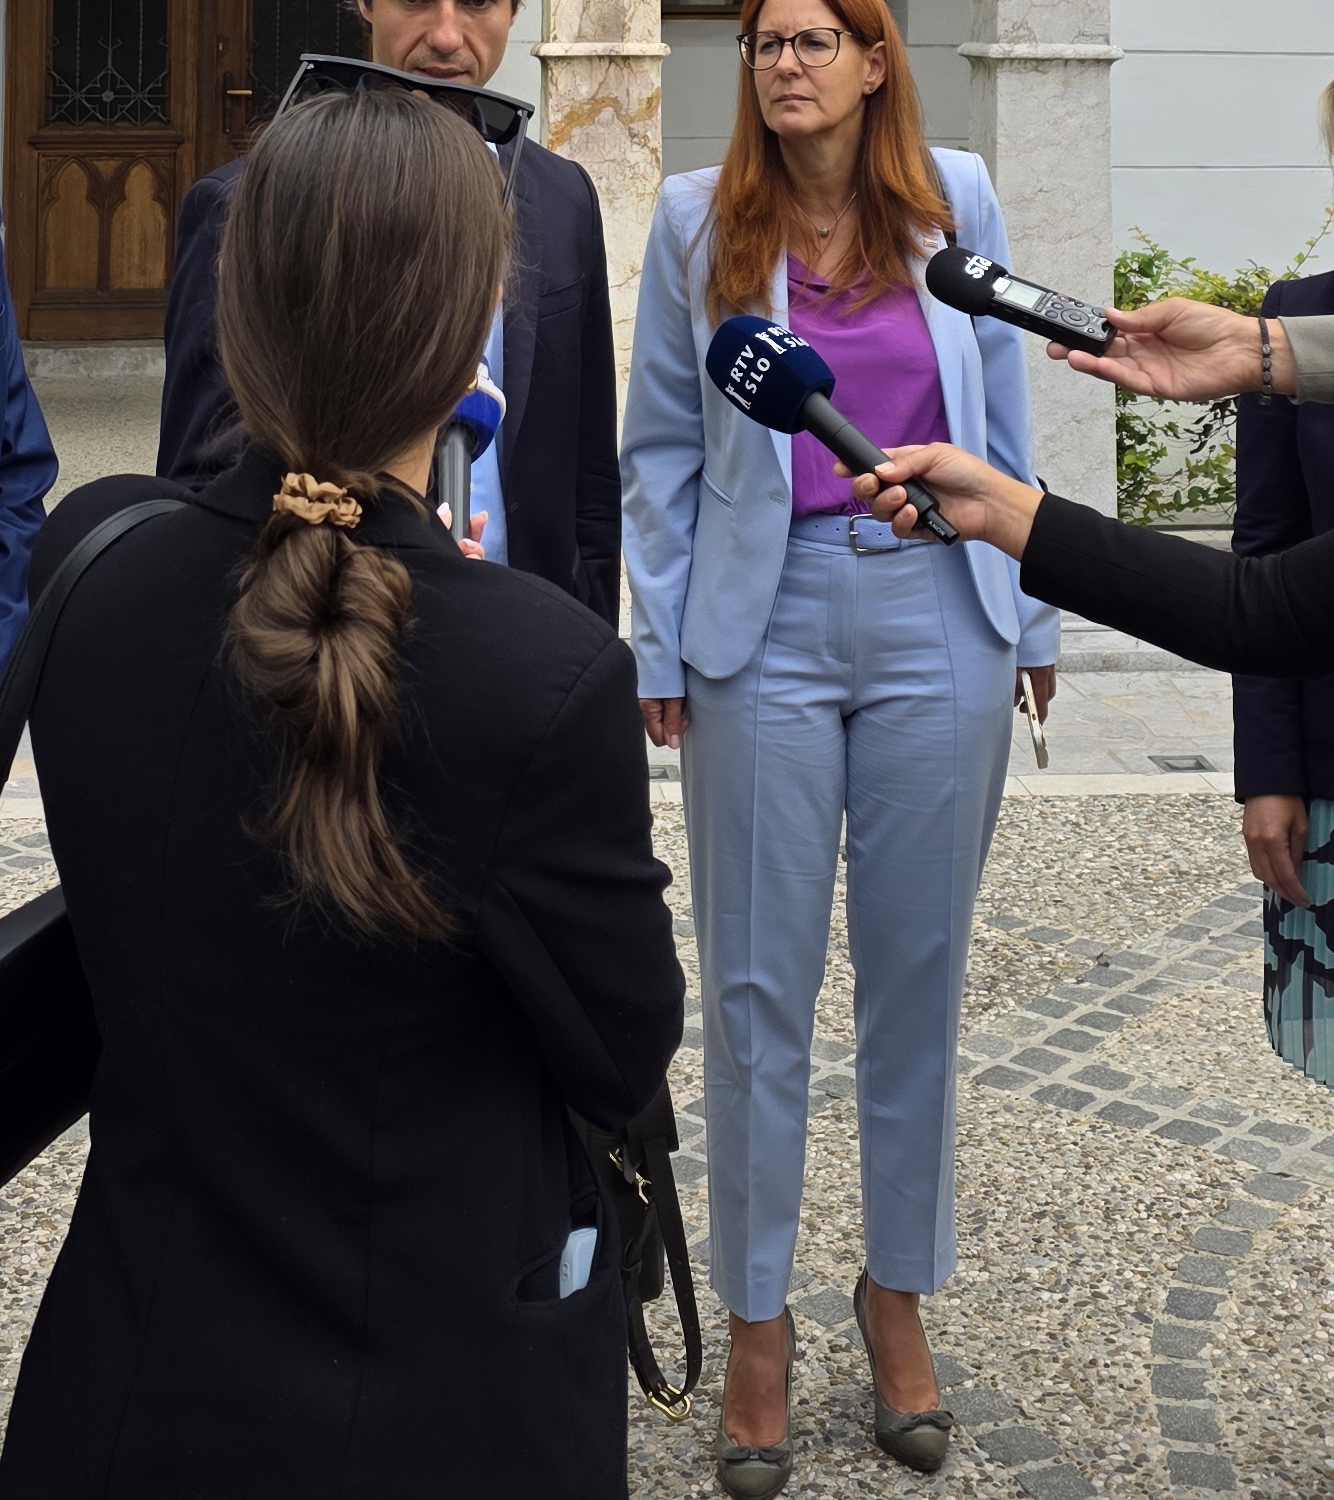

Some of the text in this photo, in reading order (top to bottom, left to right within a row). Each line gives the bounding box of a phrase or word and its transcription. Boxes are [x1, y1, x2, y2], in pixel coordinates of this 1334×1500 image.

[730, 344, 755, 383] RTV
[744, 357, 771, 395] SLO
[927, 520, 946, 537] SONY
